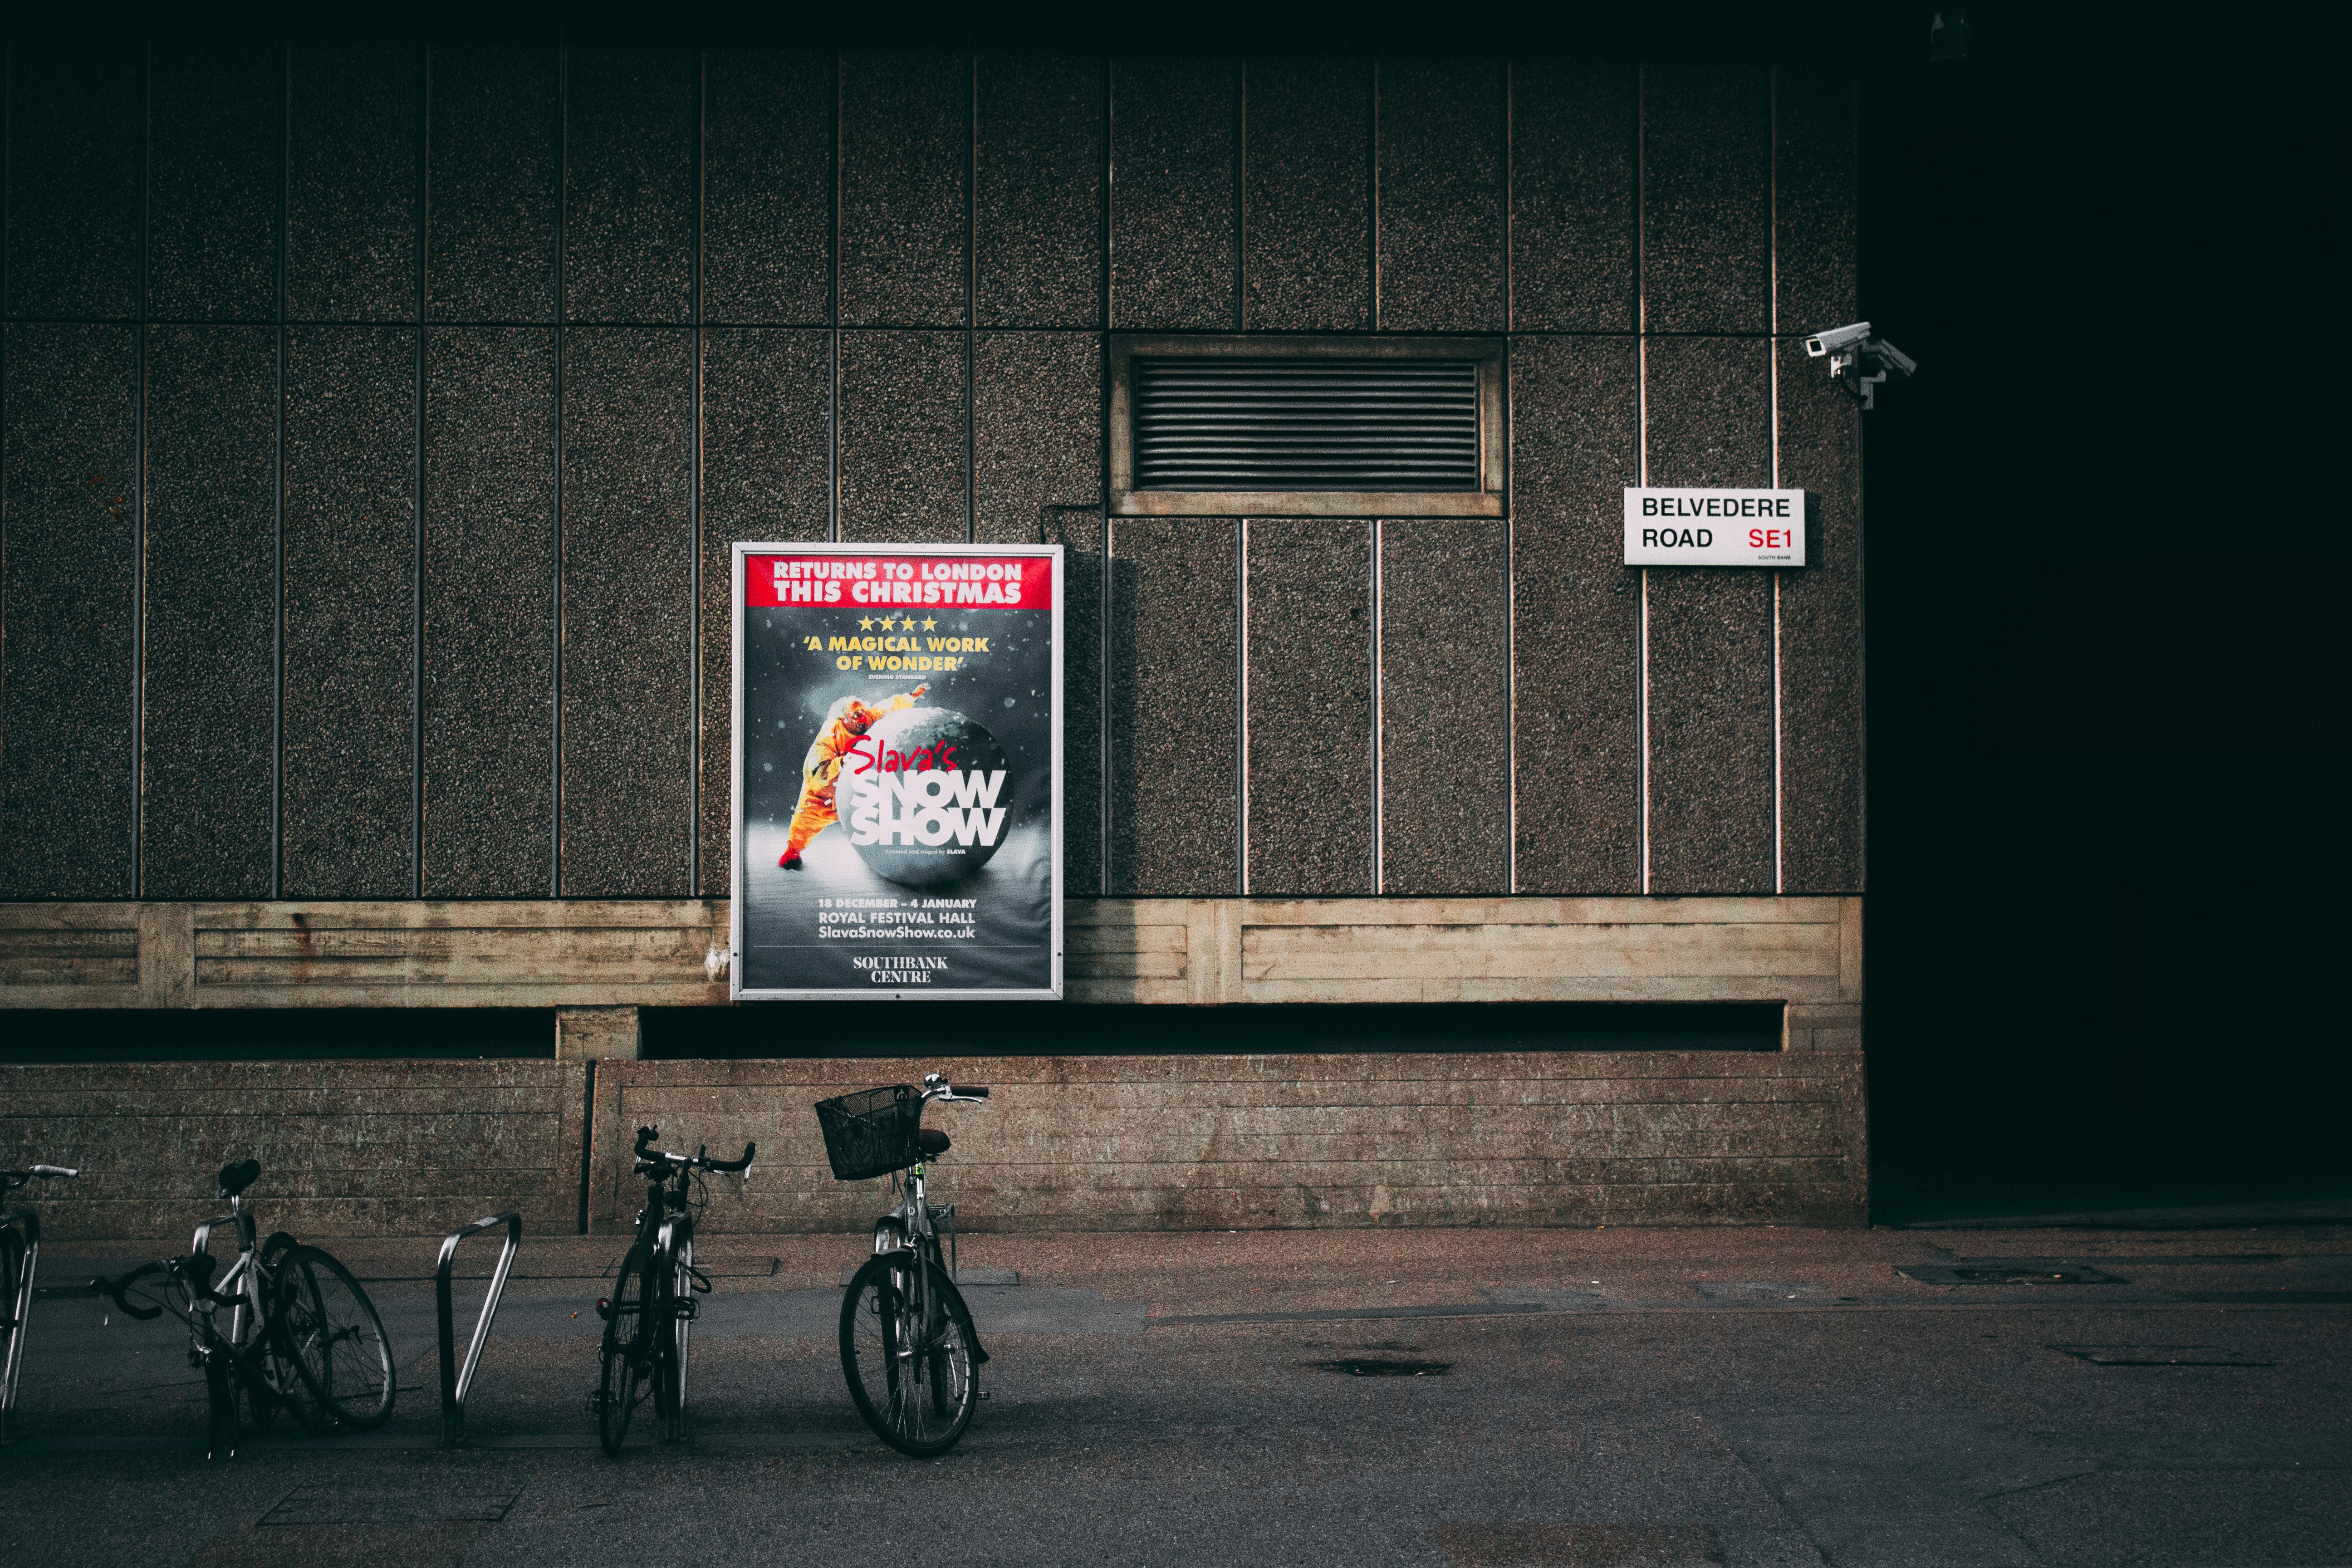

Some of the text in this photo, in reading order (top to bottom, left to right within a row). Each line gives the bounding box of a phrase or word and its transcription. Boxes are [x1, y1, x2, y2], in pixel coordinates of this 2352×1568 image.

[1642, 498, 1790, 517] BELVEDERE
[1642, 528, 1791, 548] ROAD SE1
[774, 561, 1021, 581] RETURNS TO LONDON
[774, 581, 1021, 604] THIS CHRISTMAS
[828, 636, 921, 652] MAGICAL
[926, 637, 990, 652] WORK
[836, 656, 862, 671] OF
[845, 734, 957, 774] Slava's
[850, 769, 1007, 808] SNOW
[850, 807, 1007, 846] SHOW
[818, 899, 832, 908] 18
[836, 899, 897, 908] DECEMBER
[910, 899, 918, 908] 4
[921, 899, 977, 908] JANUARY
[819, 912, 975, 924] ROYAL FESTIVAL HALL
[818, 926, 975, 938] SlavaSnowShow.co.uk
[853, 956, 948, 969] SOUTHBANK
[871, 970, 931, 983] CENTRE
